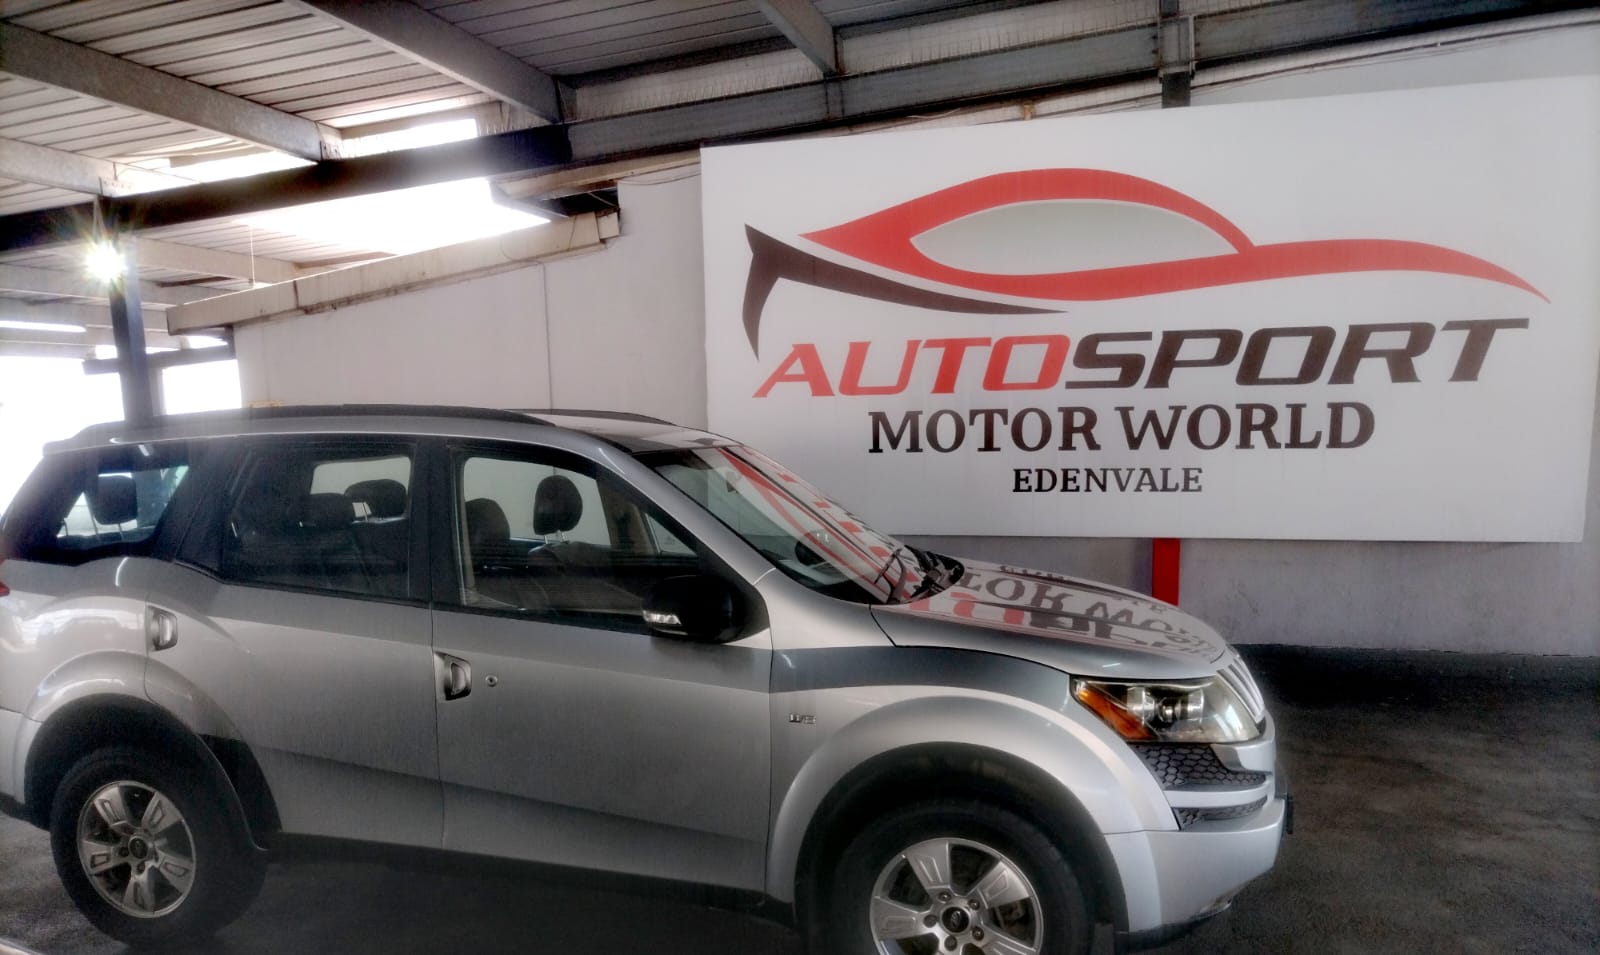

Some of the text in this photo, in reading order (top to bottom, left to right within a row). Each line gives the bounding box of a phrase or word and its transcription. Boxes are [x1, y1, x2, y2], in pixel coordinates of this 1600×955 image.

[753, 319, 1529, 398] AUTOSPORT
[869, 402, 1375, 454] MOTOR WORLD
[1012, 467, 1203, 493] EDENVALE
